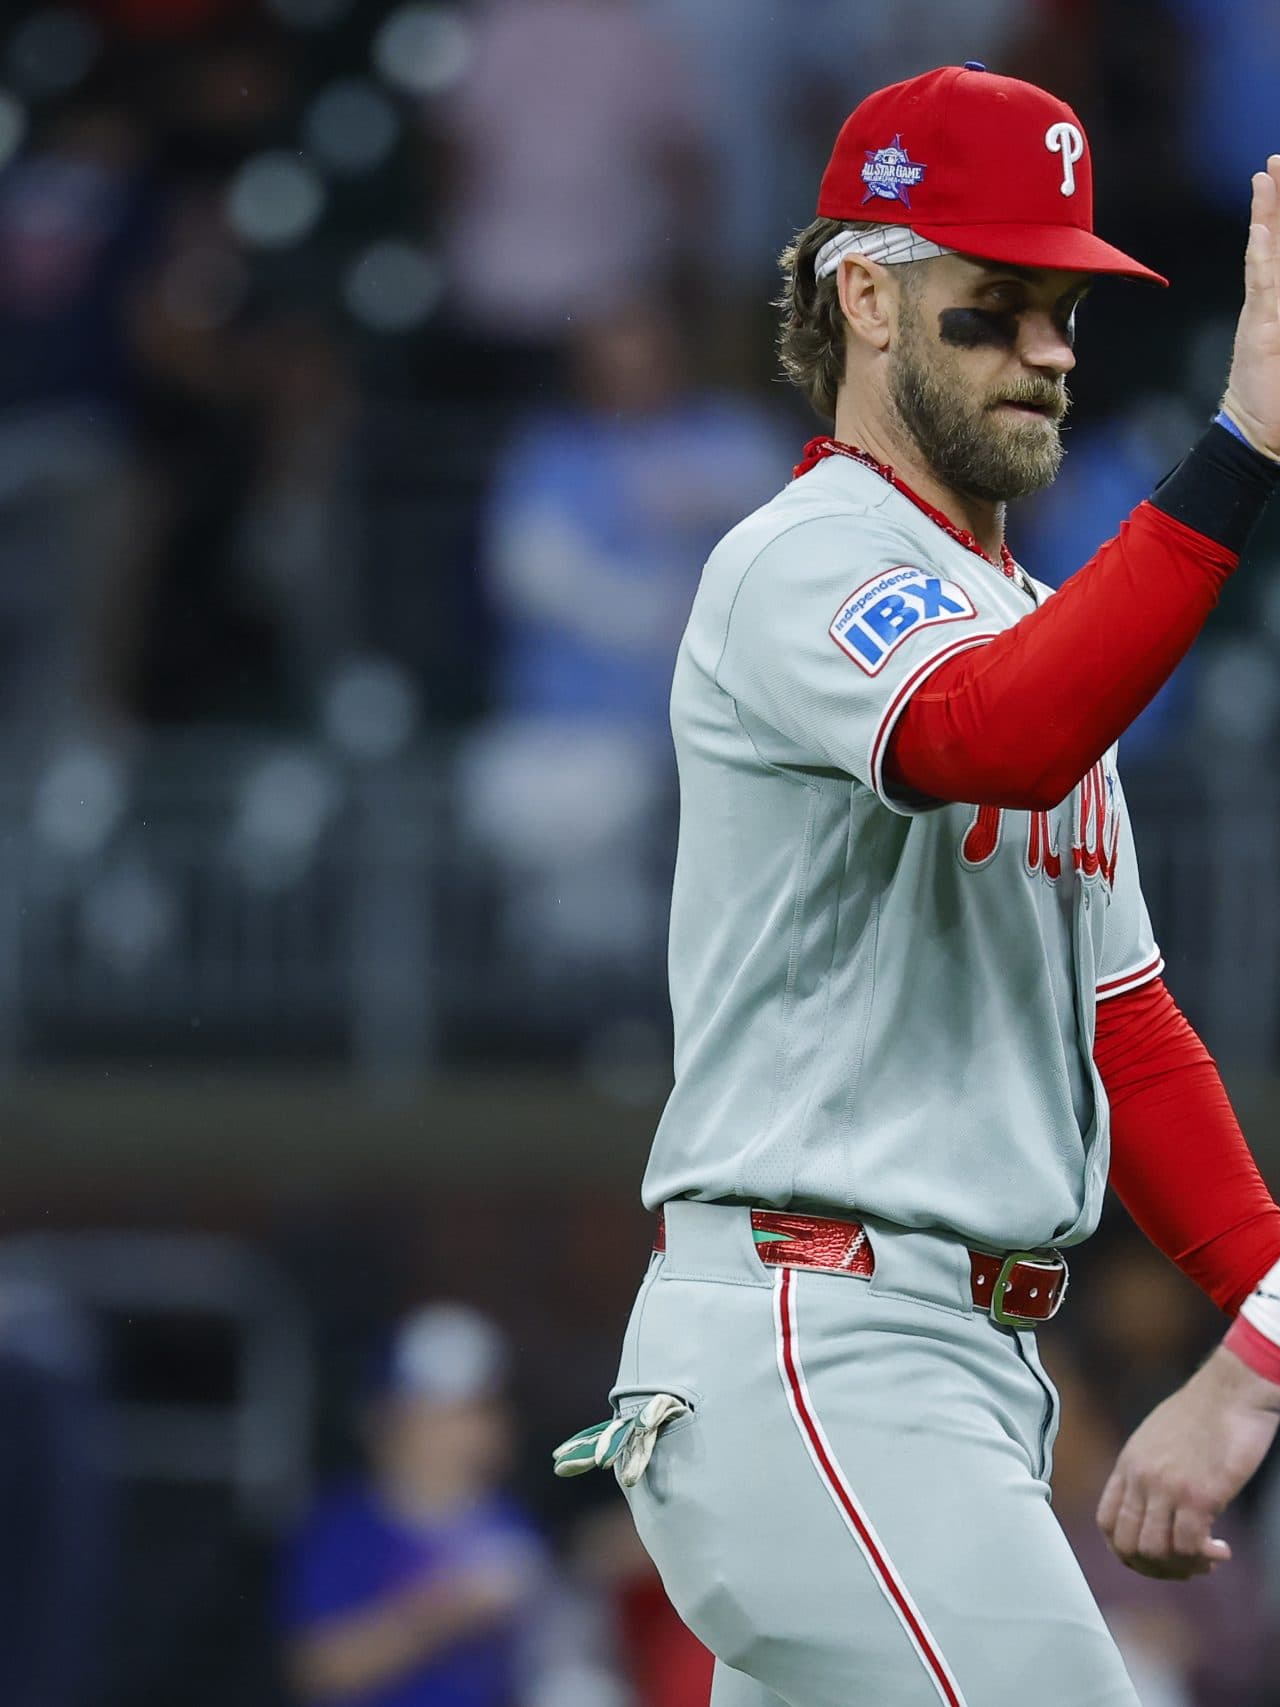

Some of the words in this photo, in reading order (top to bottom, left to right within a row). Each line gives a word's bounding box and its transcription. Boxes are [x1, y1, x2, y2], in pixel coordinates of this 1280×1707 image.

[896, 165, 922, 179] GAME
[1045, 122, 1084, 197] P
[835, 570, 919, 631] Independence
[844, 578, 966, 666] IBX
